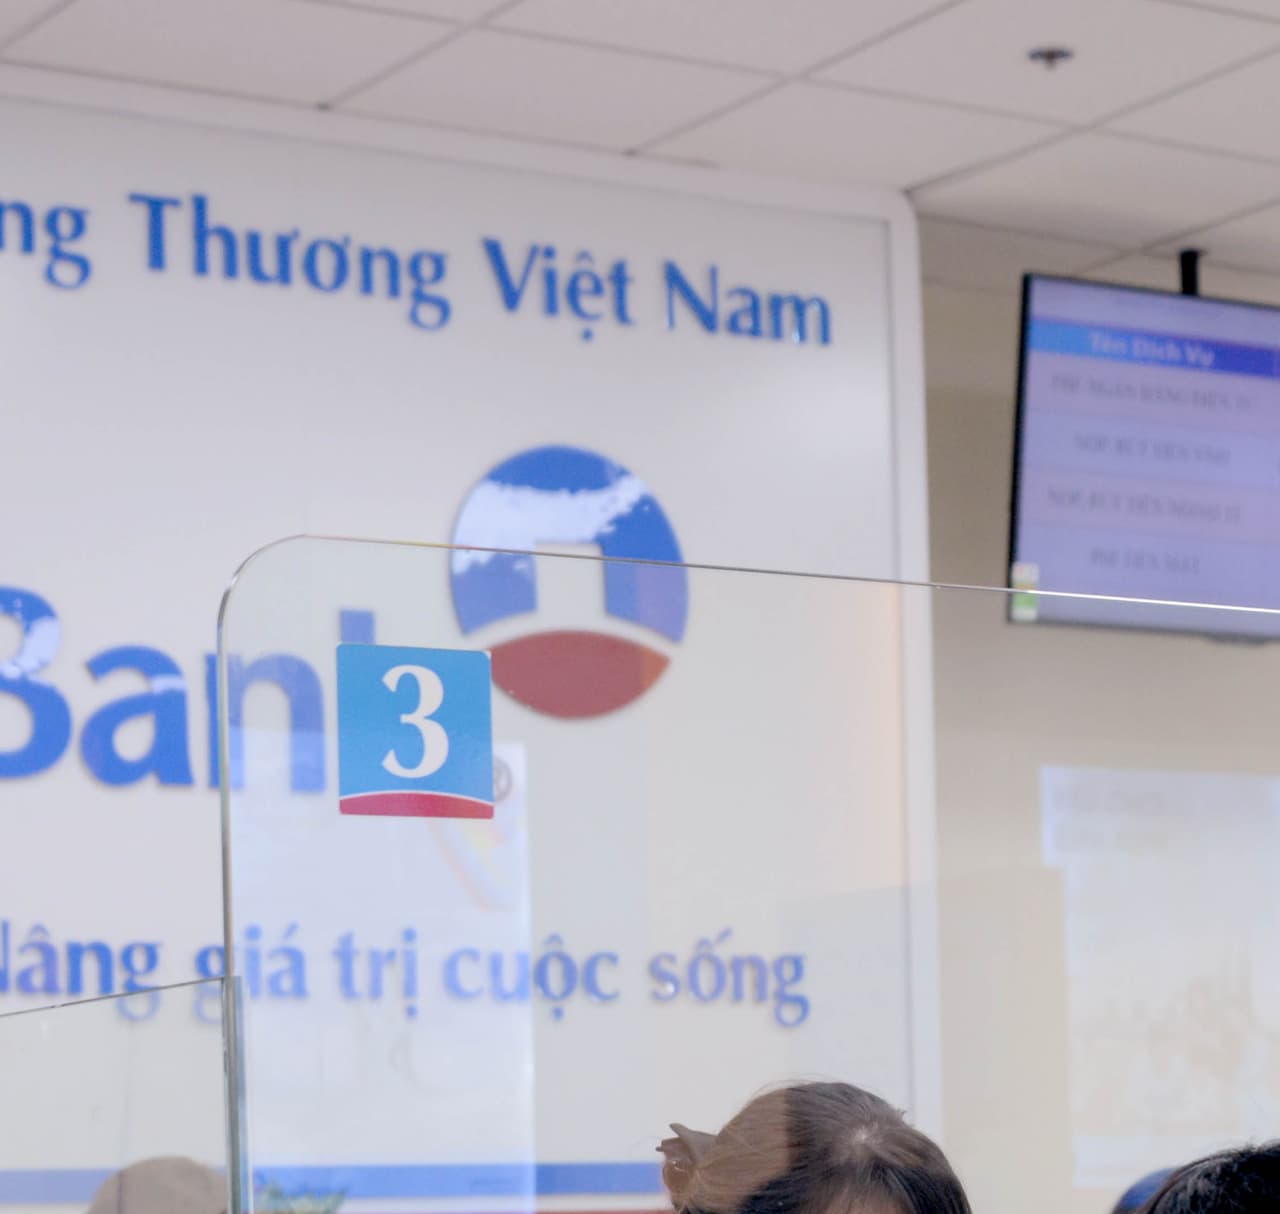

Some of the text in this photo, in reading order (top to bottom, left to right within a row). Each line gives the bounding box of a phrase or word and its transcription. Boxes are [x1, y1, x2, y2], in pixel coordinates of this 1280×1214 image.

[128, 192, 453, 331] Thương
[483, 234, 635, 342] Việt
[661, 261, 835, 347] Nam
[379, 663, 450, 779] 3
[192, 923, 310, 1025] giá
[331, 927, 419, 1018] trị
[442, 932, 620, 1020] cuộc
[649, 928, 811, 1028] sống
